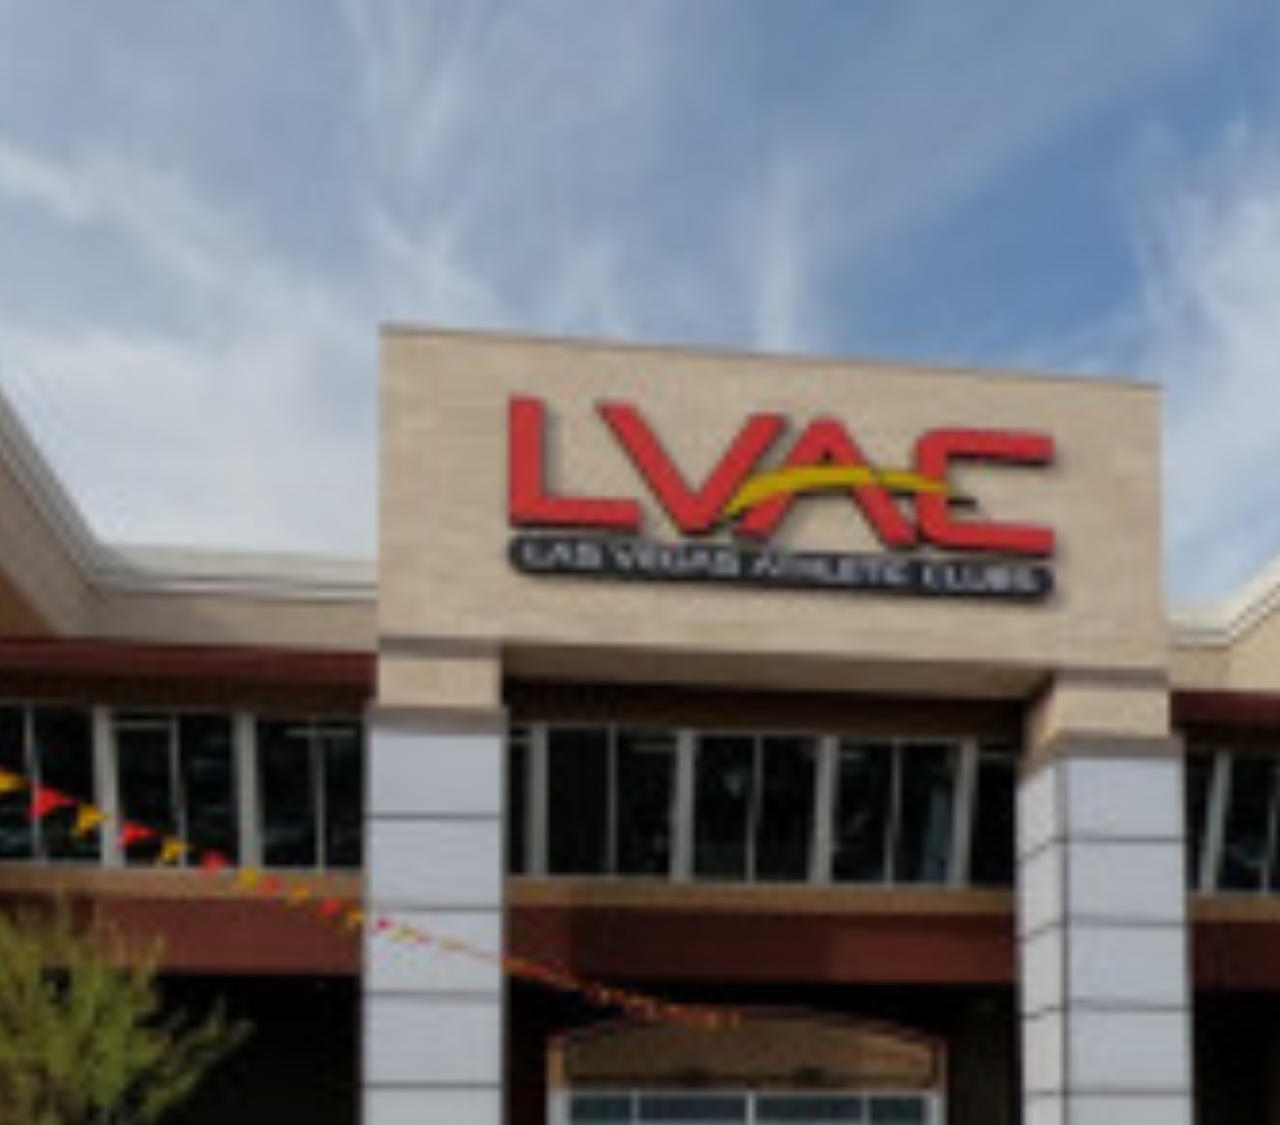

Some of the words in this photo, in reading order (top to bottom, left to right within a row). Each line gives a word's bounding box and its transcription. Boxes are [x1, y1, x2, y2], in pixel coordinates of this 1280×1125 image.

[508, 394, 1054, 556] LVAC
[522, 540, 602, 569] LAS
[611, 542, 739, 576] VEGAS
[751, 554, 909, 584] ATHLETIC
